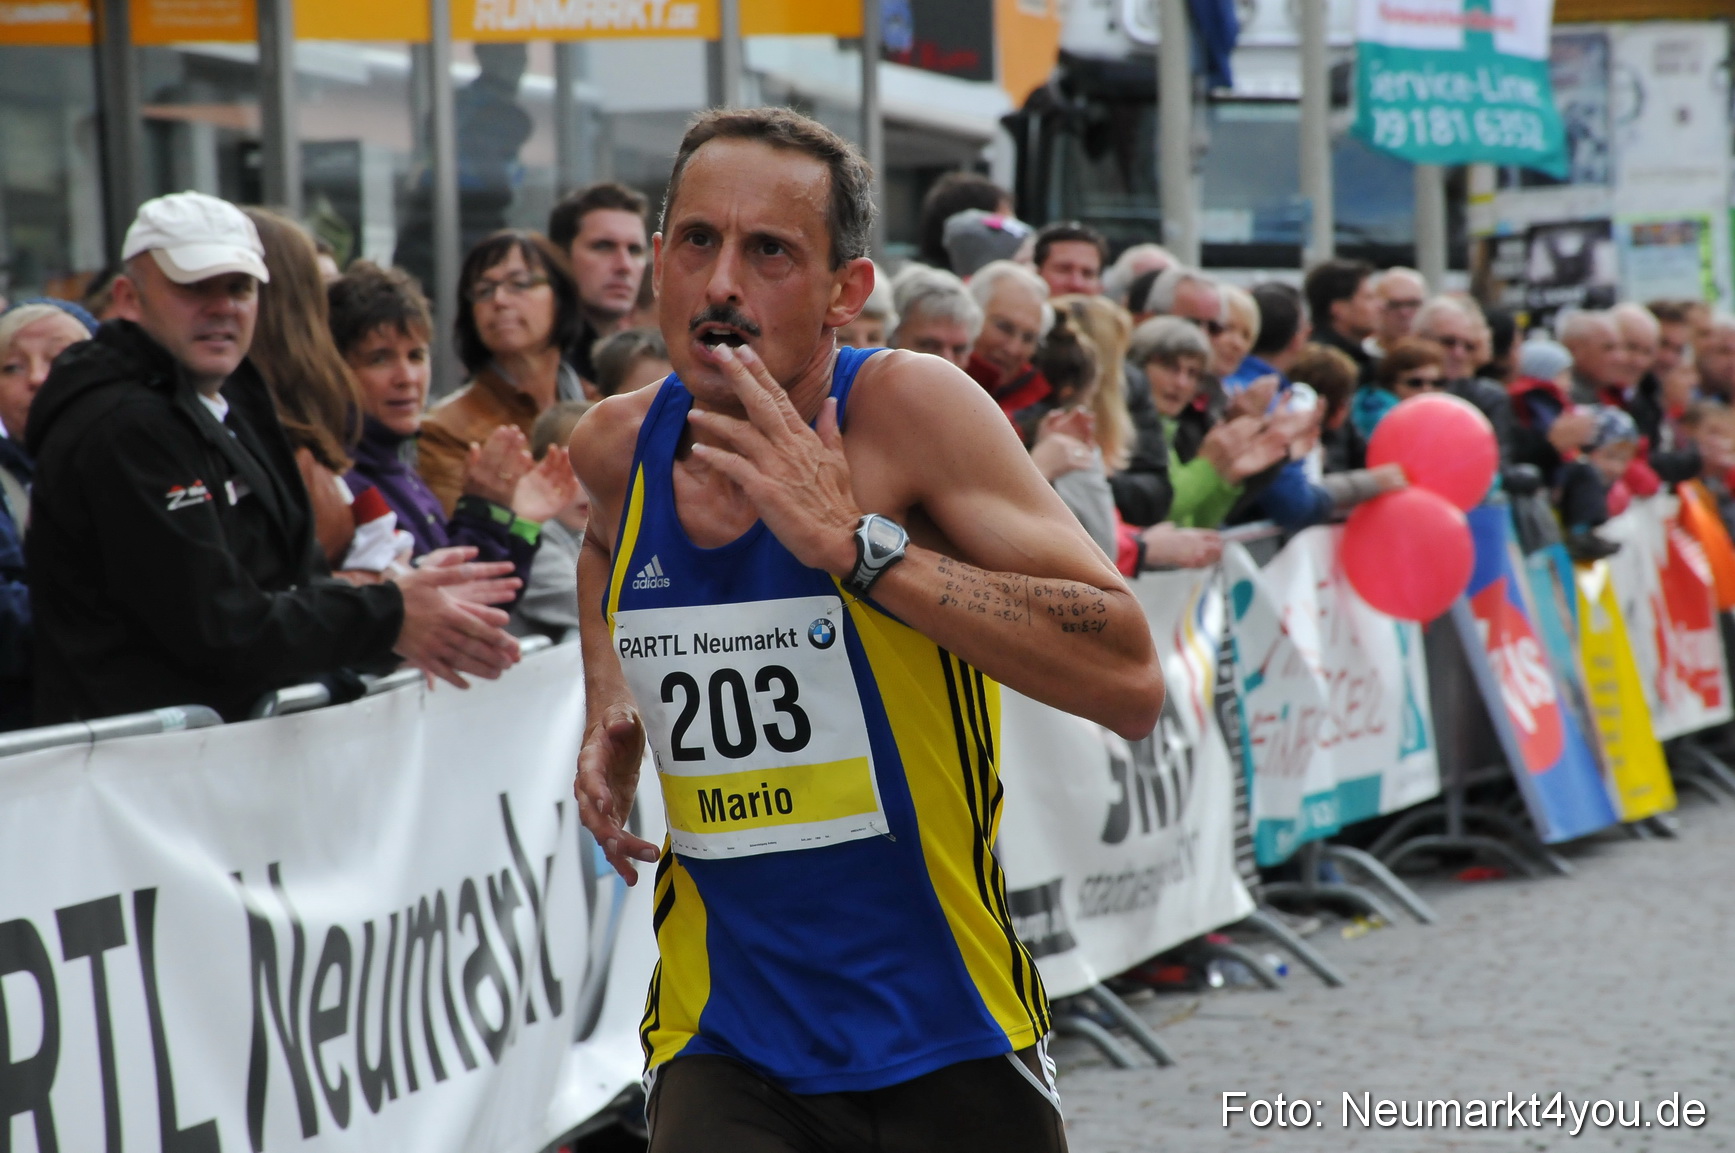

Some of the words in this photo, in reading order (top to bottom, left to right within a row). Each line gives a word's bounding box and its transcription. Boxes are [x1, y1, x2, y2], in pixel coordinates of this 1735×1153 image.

[632, 575, 671, 590] adidas
[619, 634, 687, 659] PARTL
[693, 627, 799, 655] Neumarkt
[660, 664, 812, 762] 203
[697, 781, 794, 824] Mario
